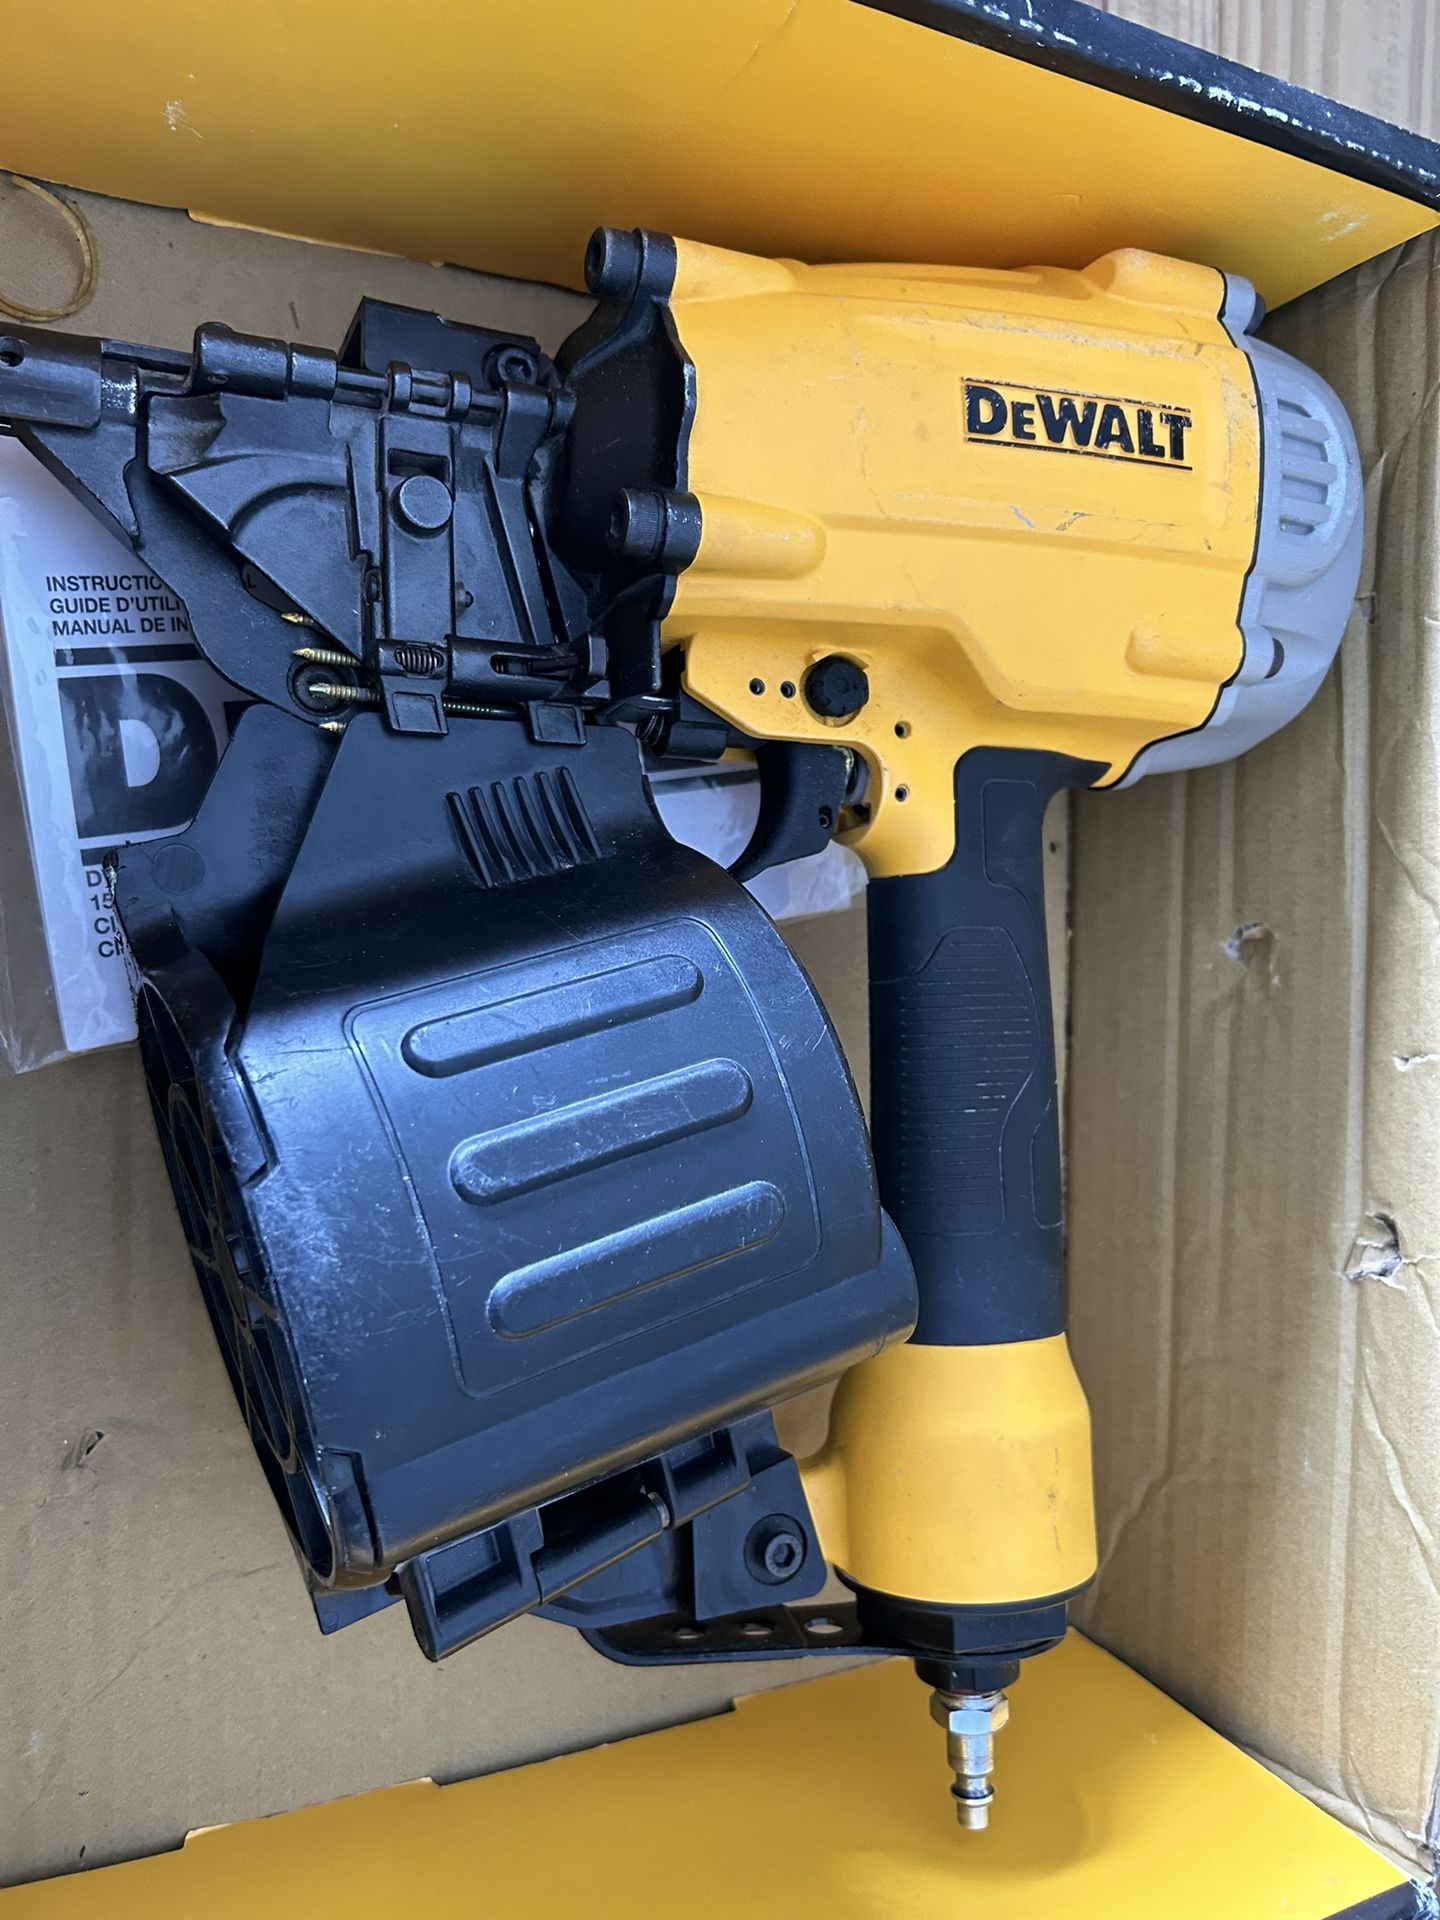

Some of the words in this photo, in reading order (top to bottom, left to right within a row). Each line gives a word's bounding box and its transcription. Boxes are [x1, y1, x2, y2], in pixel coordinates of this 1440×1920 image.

[45, 575, 163, 592] INSTRUCTIO
[49, 597, 111, 614] GUIDE
[115, 596, 180, 613] D'UTILI
[51, 618, 136, 636] MANUAL
[140, 617, 166, 633] DE
[170, 617, 189, 632] IN
